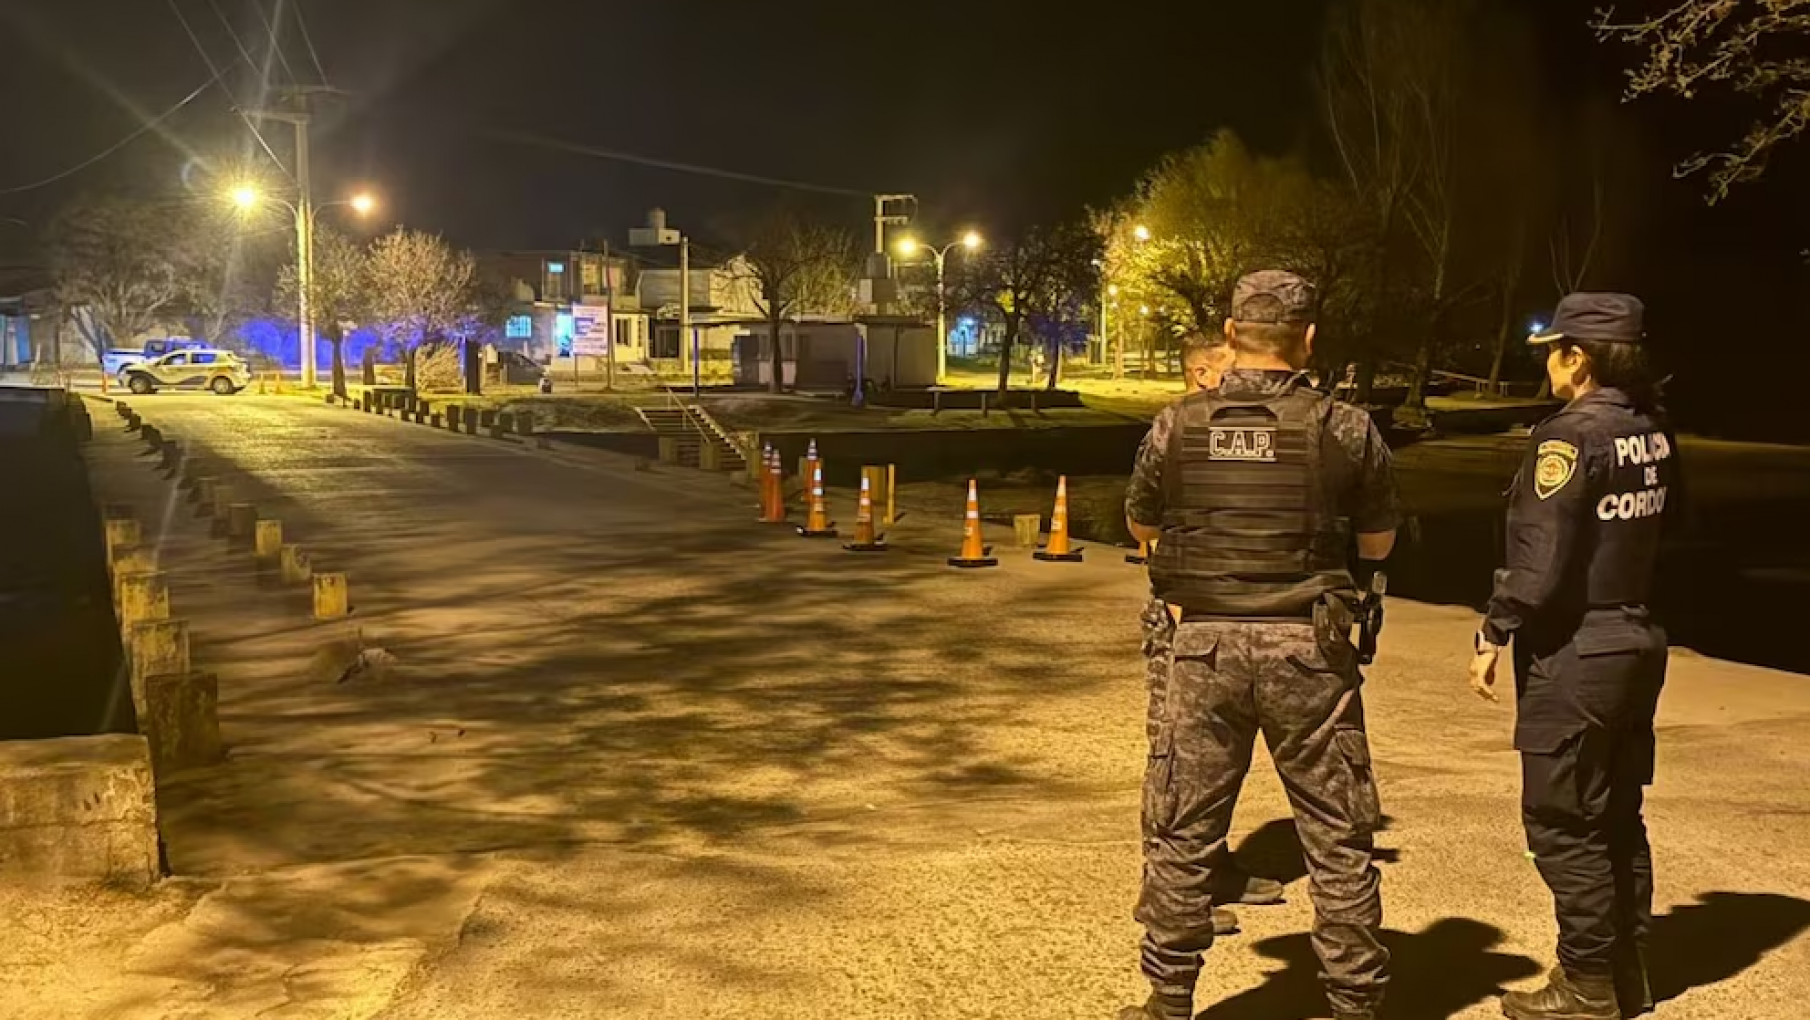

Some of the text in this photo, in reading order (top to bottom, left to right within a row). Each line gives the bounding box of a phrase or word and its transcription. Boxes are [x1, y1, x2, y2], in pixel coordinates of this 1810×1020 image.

[1209, 431, 1274, 457] C.A.P.
[1643, 466, 1658, 486] DE
[1596, 486, 1667, 520] CORDO
